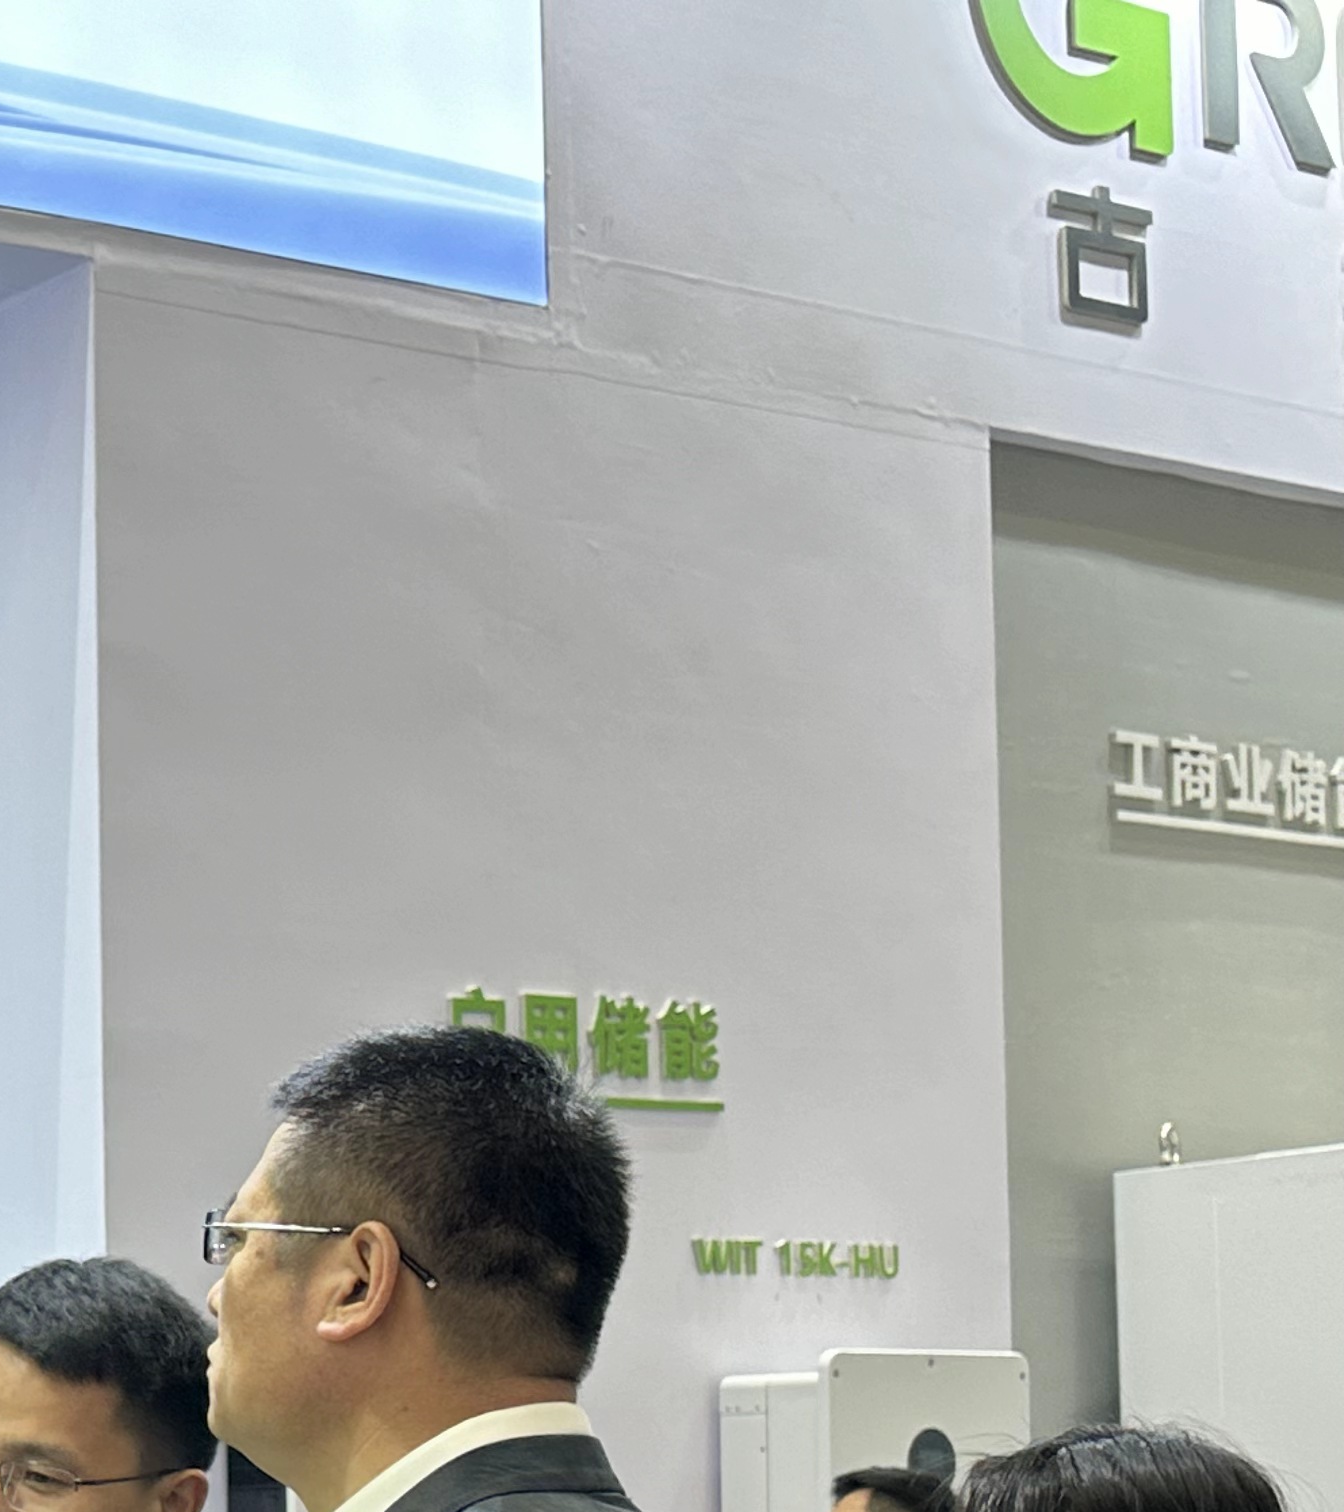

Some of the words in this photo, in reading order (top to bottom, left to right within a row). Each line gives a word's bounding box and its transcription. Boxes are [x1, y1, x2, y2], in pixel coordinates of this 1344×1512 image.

[968, 0, 1344, 178] GR
[1047, 185, 1153, 334] 古
[692, 1234, 764, 1276] WIT
